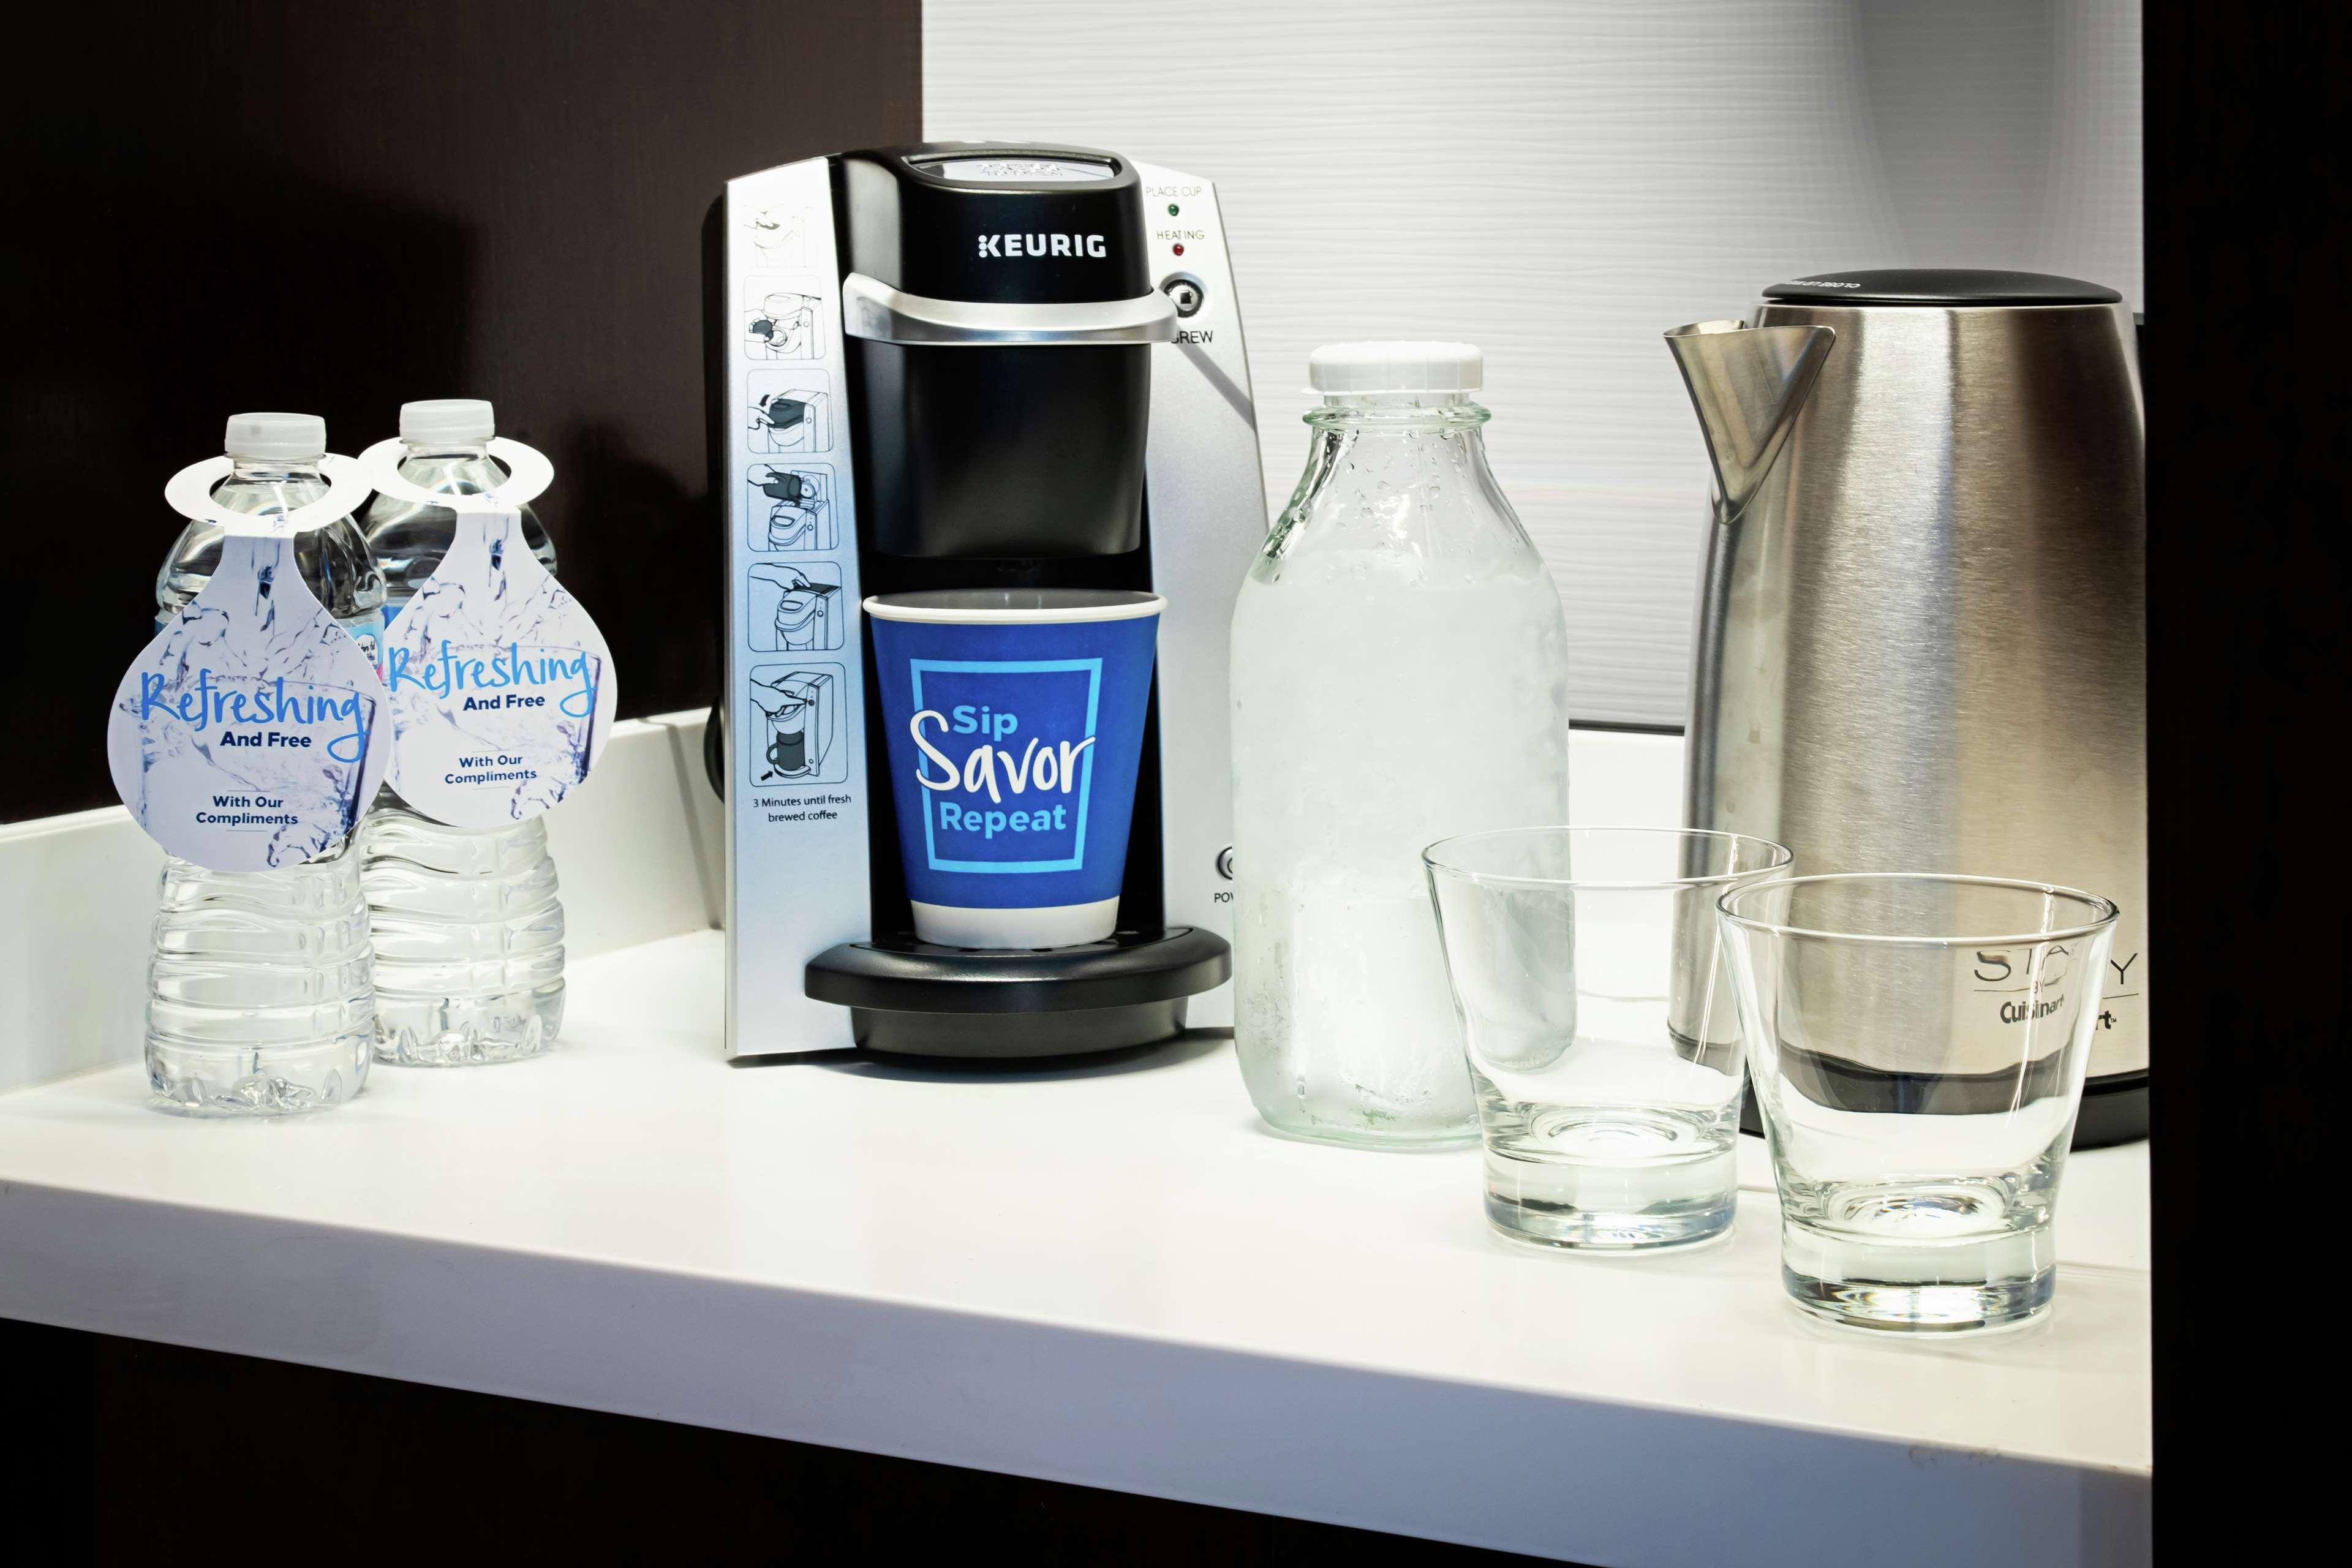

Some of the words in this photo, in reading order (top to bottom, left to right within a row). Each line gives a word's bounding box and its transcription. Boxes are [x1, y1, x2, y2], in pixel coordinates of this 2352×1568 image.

[1145, 186, 1178, 196] PLACE
[1182, 186, 1202, 196] CUP
[1157, 230, 1205, 239] HEATING
[978, 234, 1106, 258] KEURIG
[389, 639, 597, 717] Refreshing
[463, 696, 500, 710] And
[506, 695, 546, 708] Free
[141, 668, 369, 763] Refreshing
[952, 705, 1018, 742] Sip
[220, 731, 262, 746] And
[268, 732, 311, 747] Free
[459, 756, 493, 767] With
[497, 755, 523, 765] Our
[910, 710, 1096, 804] Savor
[445, 769, 537, 784] Compliments
[213, 796, 251, 807] With
[255, 796, 284, 807] Our
[753, 799, 758, 807] 3
[761, 797, 801, 807] Minutes
[804, 795, 826, 805] until
[828, 794, 851, 804] fresh
[196, 812, 298, 826] Compliments
[768, 812, 805, 822] brewed
[808, 810, 837, 820] coffee
[940, 801, 1066, 839] Repeat
